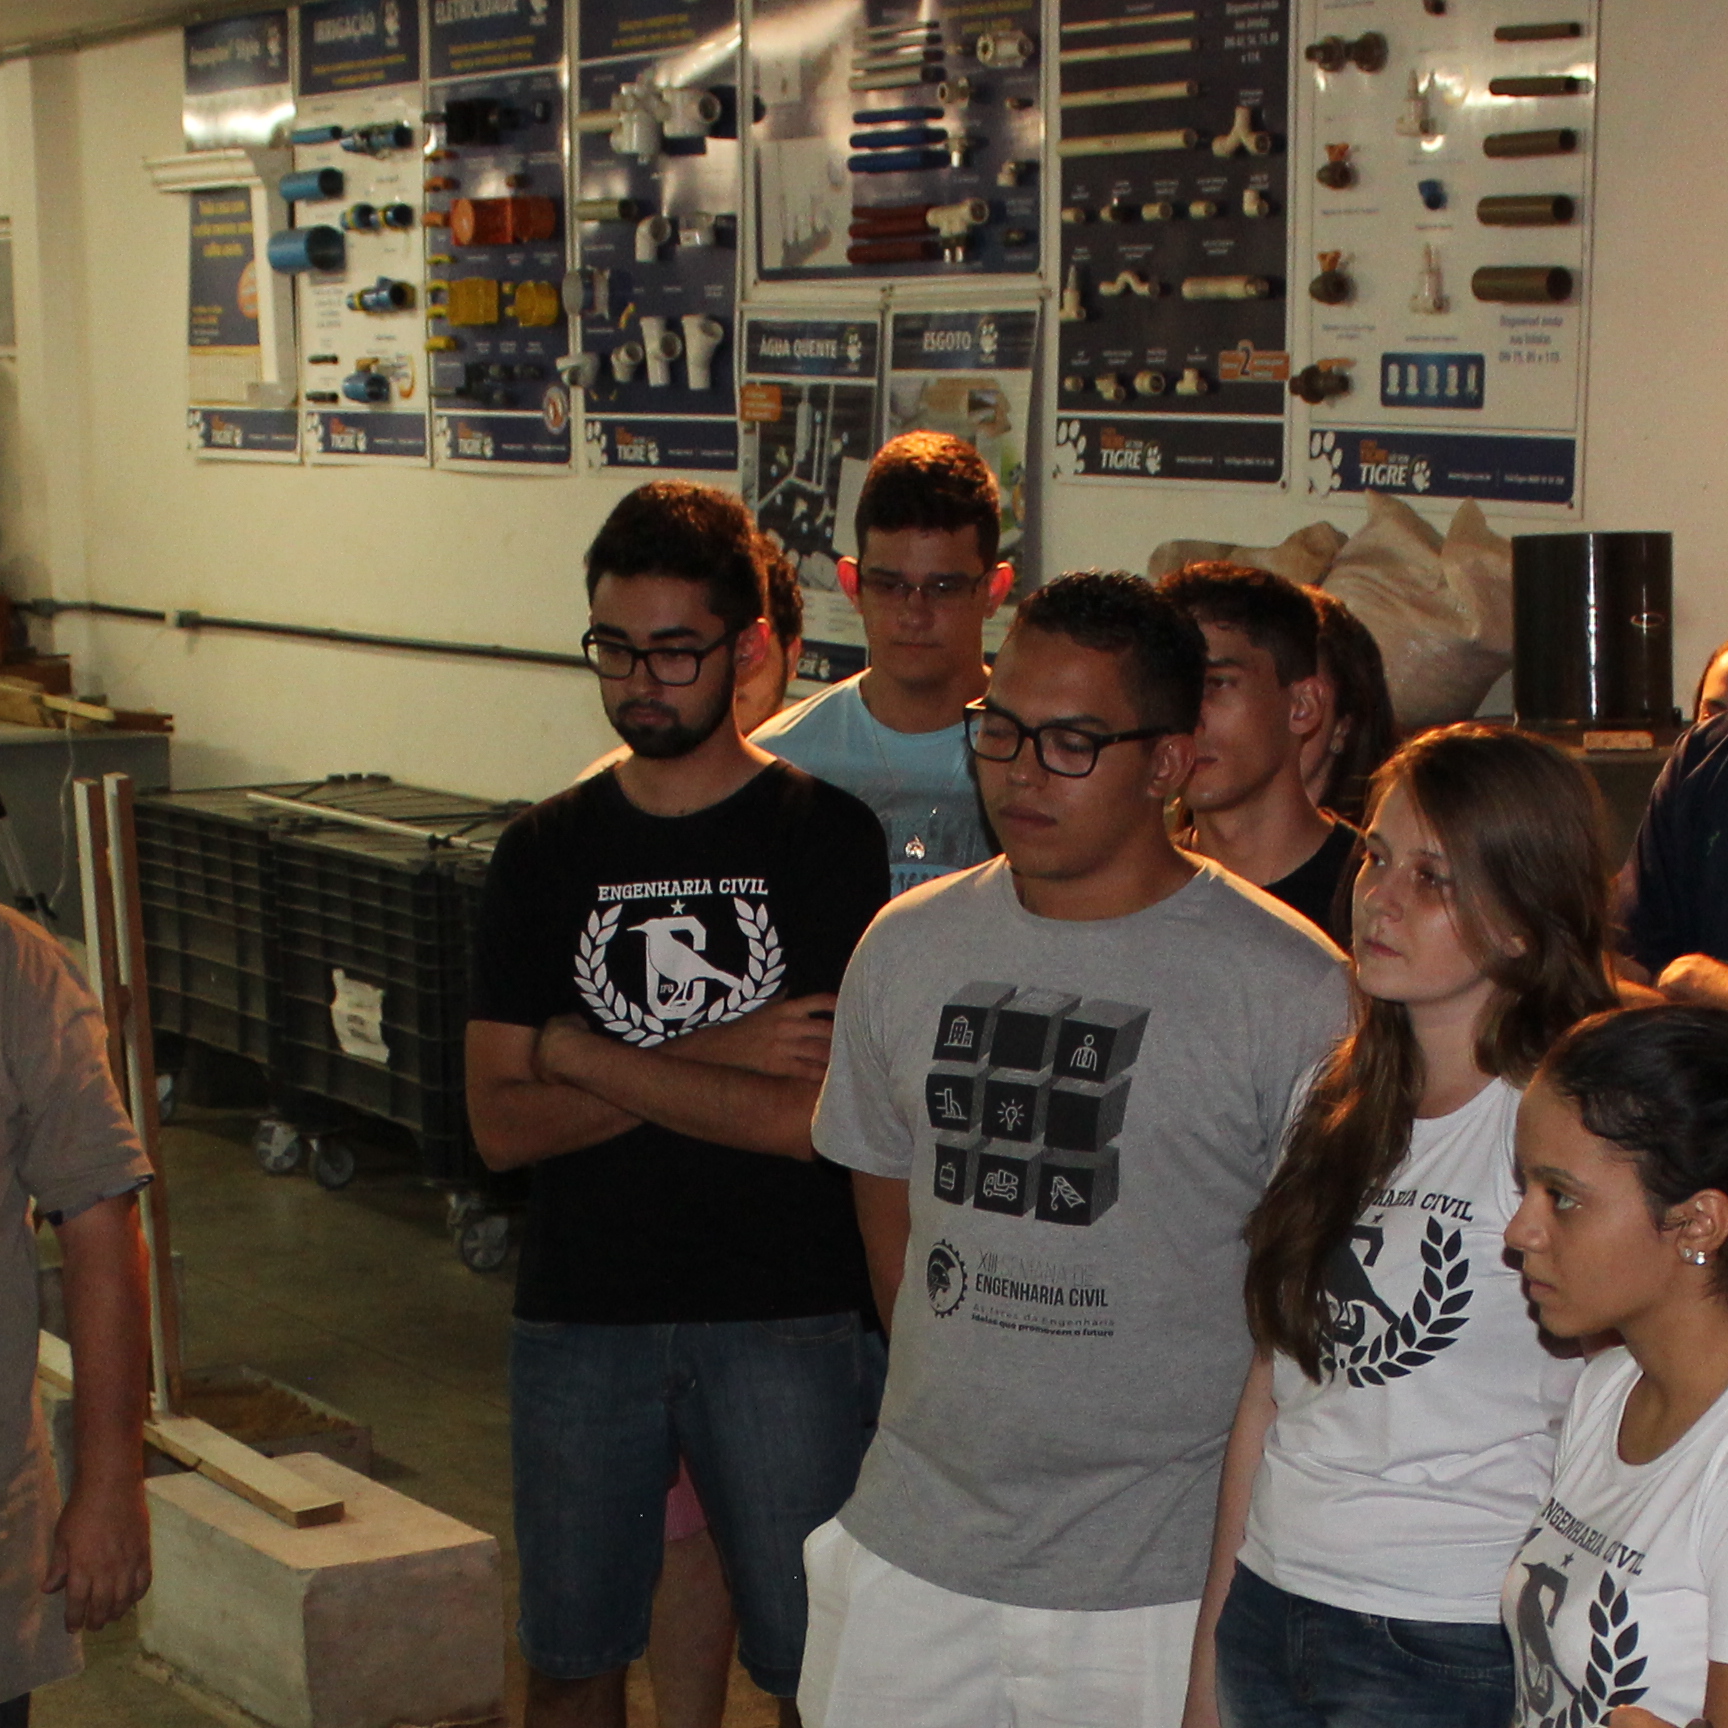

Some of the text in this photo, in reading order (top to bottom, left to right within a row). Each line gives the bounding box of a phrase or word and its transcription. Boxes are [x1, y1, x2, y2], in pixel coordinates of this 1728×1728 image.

[759, 334, 838, 359] ÁGUA QUENTE
[923, 331, 972, 351] ESGOTO
[1100, 448, 1143, 470] TIGRE
[1359, 463, 1409, 487] TIGRE
[597, 877, 769, 901] ENGENHARIA CIVIL
[1420, 1193, 1474, 1222] CIVIL
[975, 1273, 1109, 1307] ENGENHARIA CIVIL
[1541, 1497, 1608, 1557] NGENHARIA
